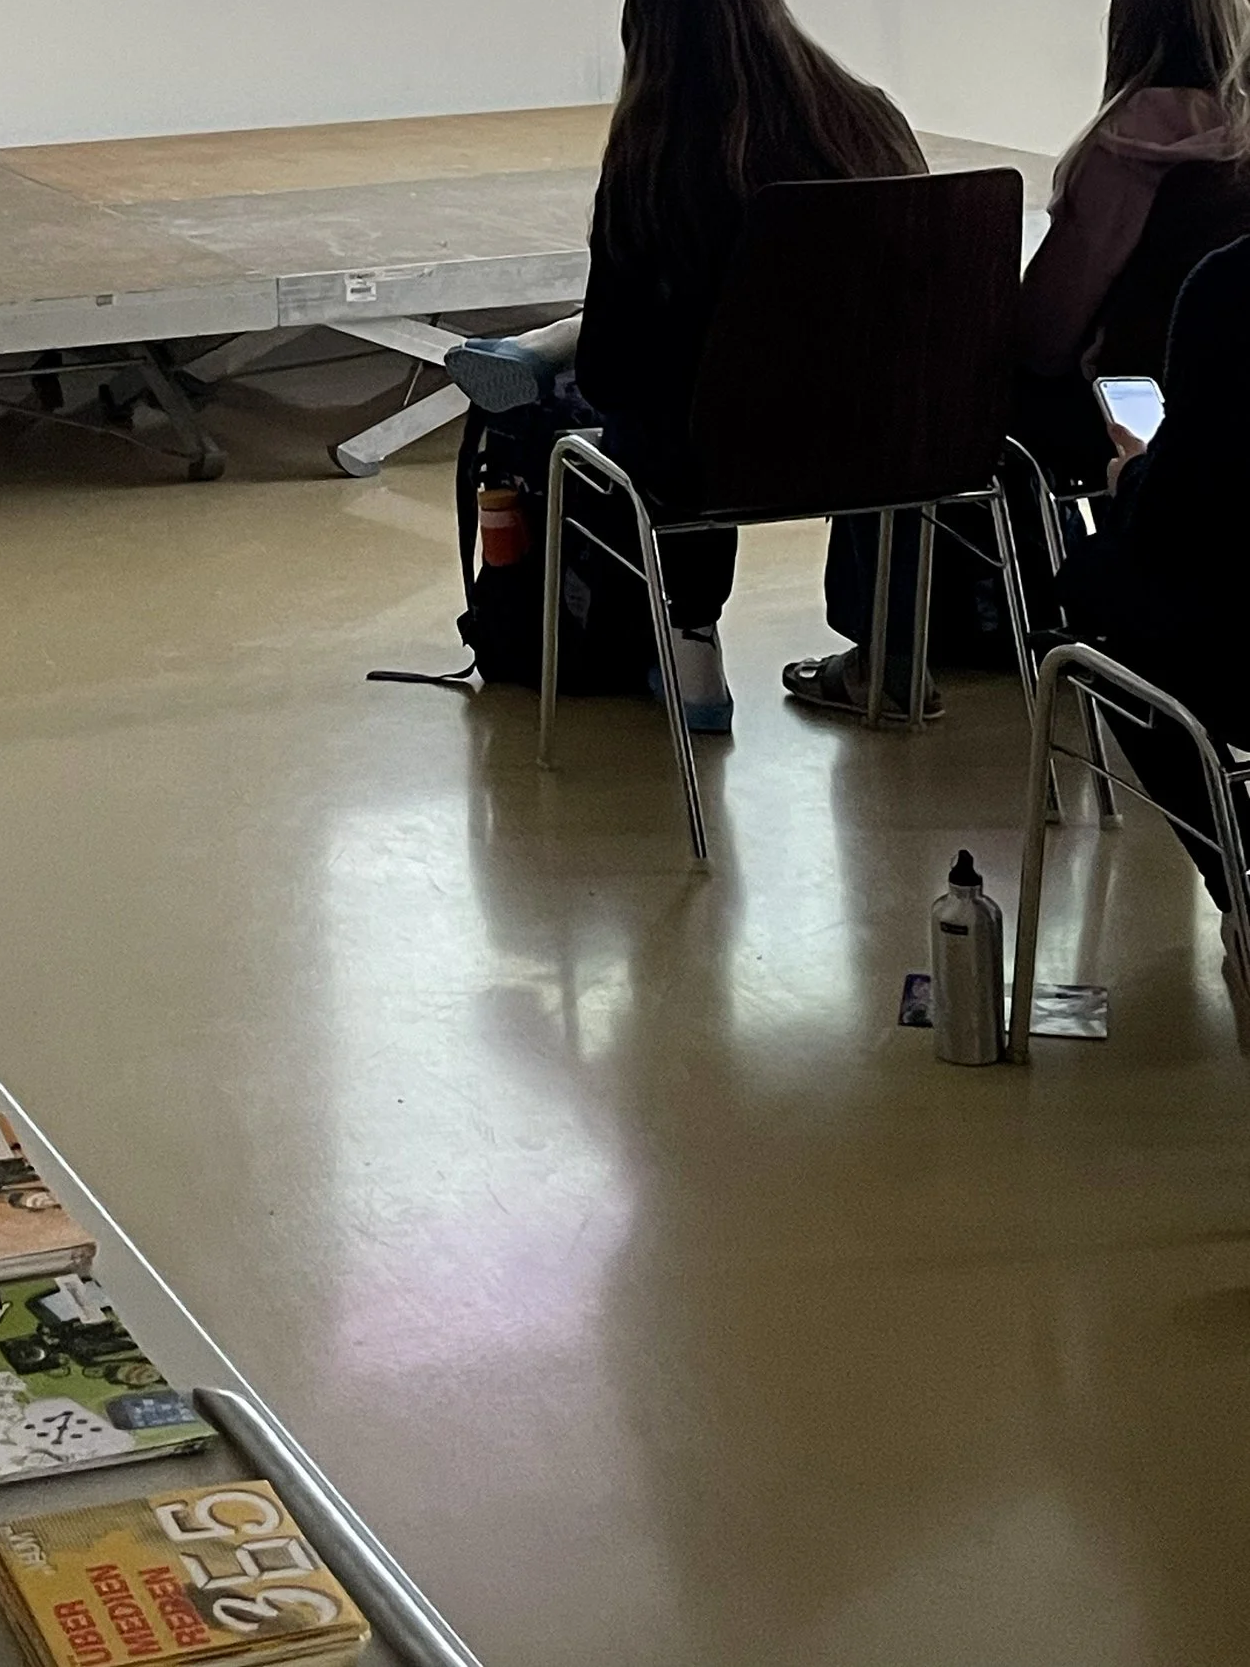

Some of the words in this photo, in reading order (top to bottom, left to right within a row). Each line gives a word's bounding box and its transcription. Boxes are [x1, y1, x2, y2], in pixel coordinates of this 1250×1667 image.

[138, 1564, 211, 1648] REDEN
[154, 1489, 340, 1634] 365
[53, 1598, 113, 1667] ÜBER
[85, 1562, 163, 1657] MEDIEN
